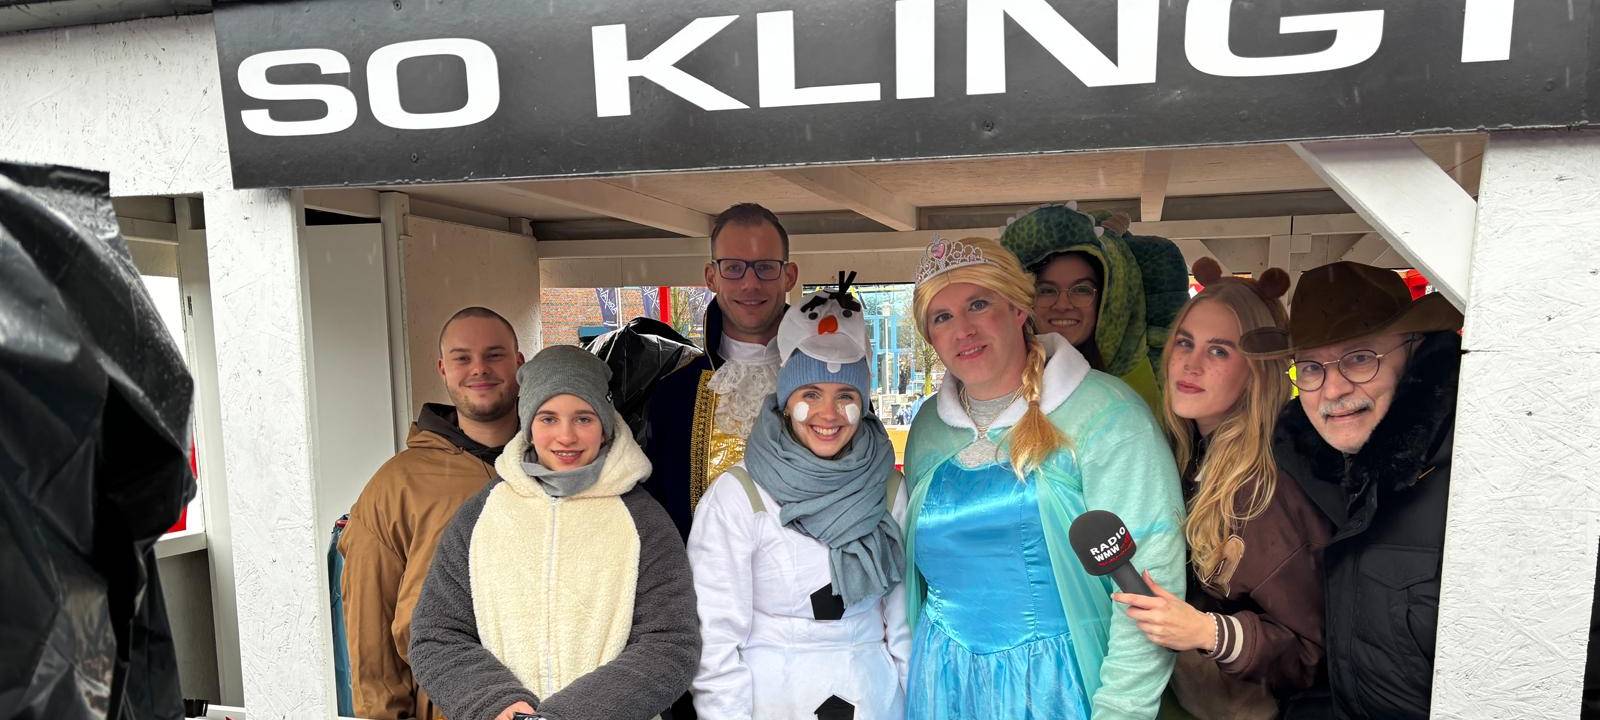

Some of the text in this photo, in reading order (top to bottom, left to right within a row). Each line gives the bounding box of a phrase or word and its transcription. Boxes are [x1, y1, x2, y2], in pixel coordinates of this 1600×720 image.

[237, 38, 500, 137] SO
[1090, 526, 1126, 556] RADIO
[1094, 543, 1120, 562] WMW
